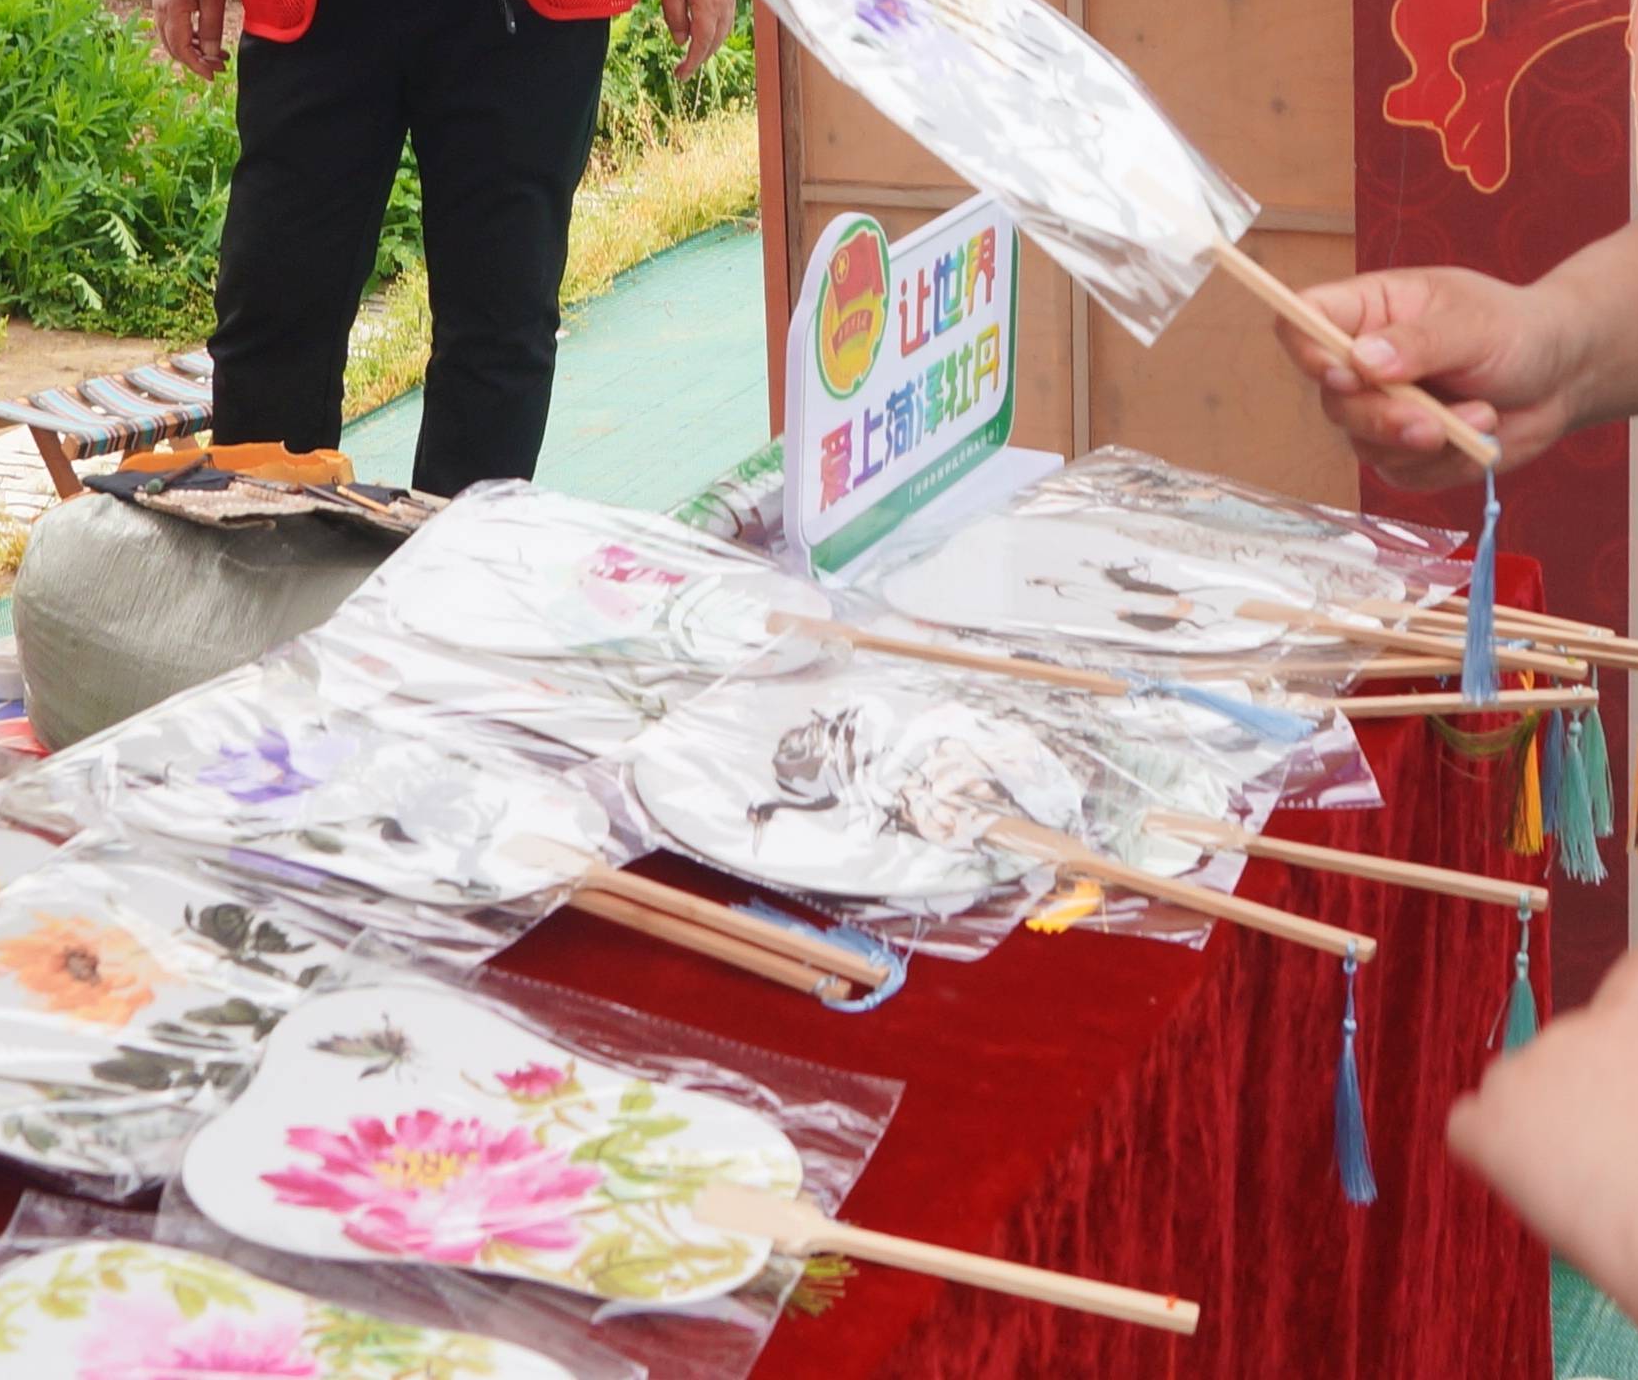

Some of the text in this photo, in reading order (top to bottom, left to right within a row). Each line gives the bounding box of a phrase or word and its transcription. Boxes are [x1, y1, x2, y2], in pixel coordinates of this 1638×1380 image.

[899, 226, 997, 357] 让世界
[819, 322, 1001, 515] 爱上菏泽牡丹
